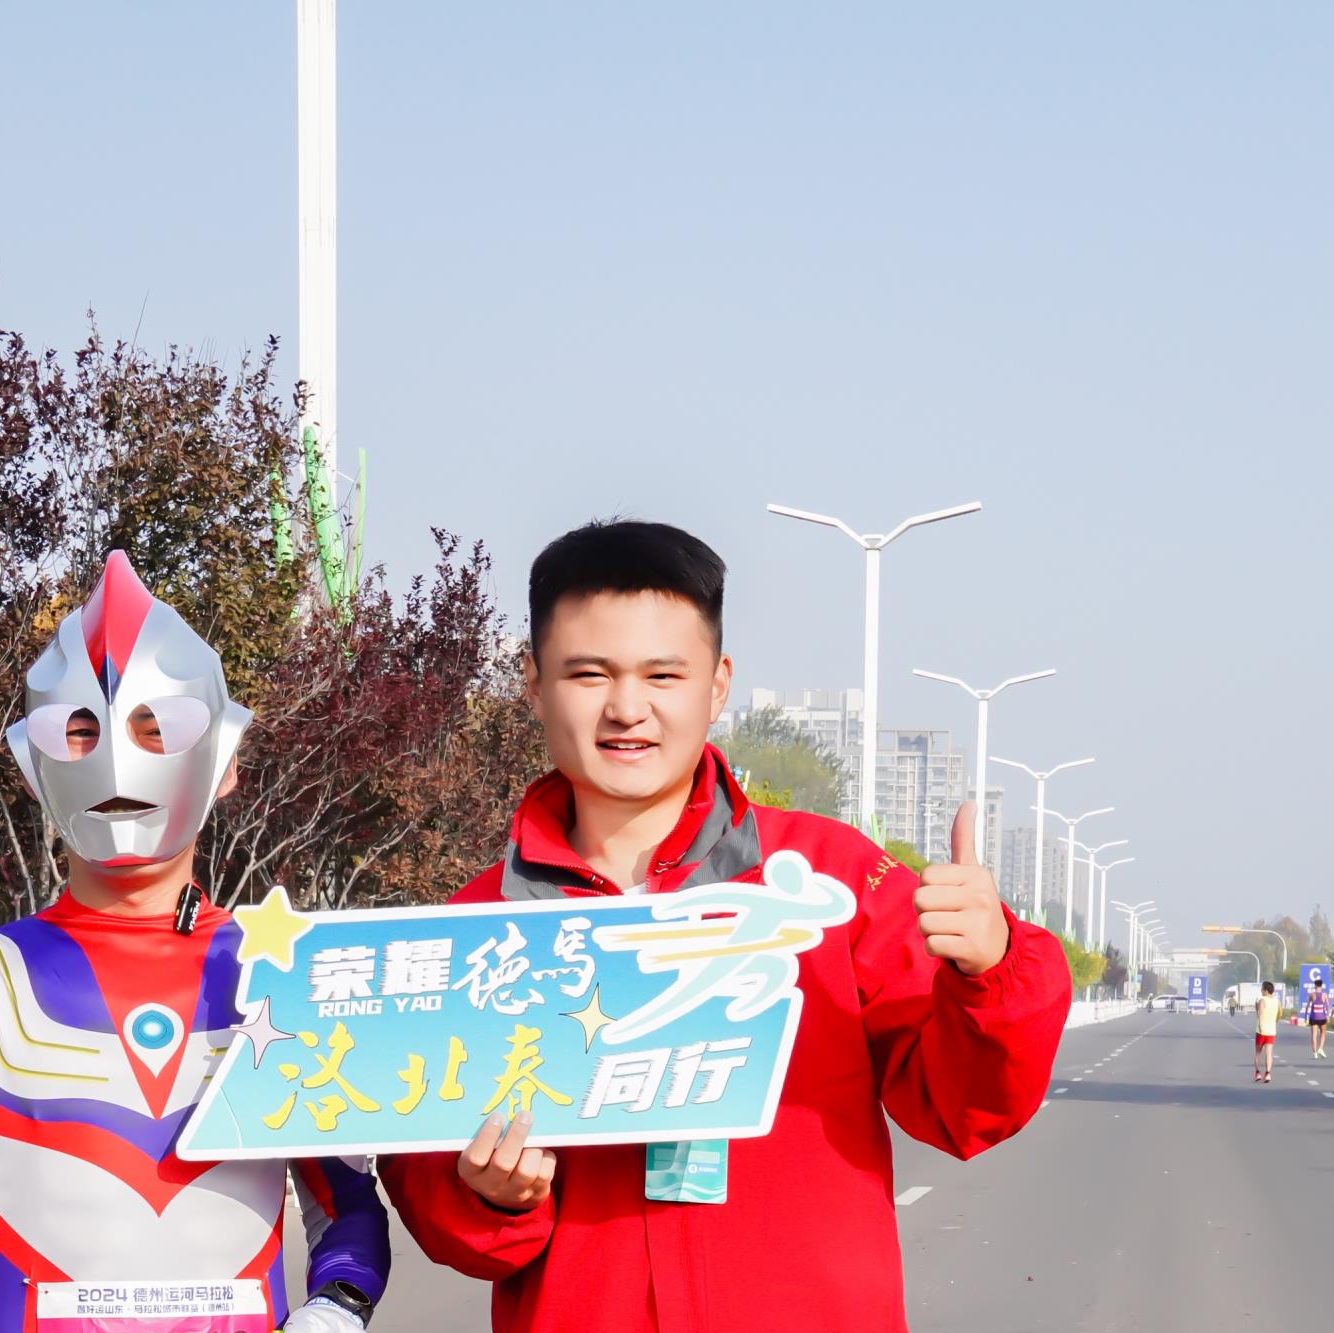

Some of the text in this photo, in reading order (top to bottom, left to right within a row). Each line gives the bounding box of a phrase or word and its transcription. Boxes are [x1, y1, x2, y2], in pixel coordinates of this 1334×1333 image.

[1310, 967, 1322, 982] C
[1194, 978, 1202, 987] D
[318, 995, 442, 1018] RONG YAO
[78, 1286, 234, 1302] 2024 德州运河马拉松
